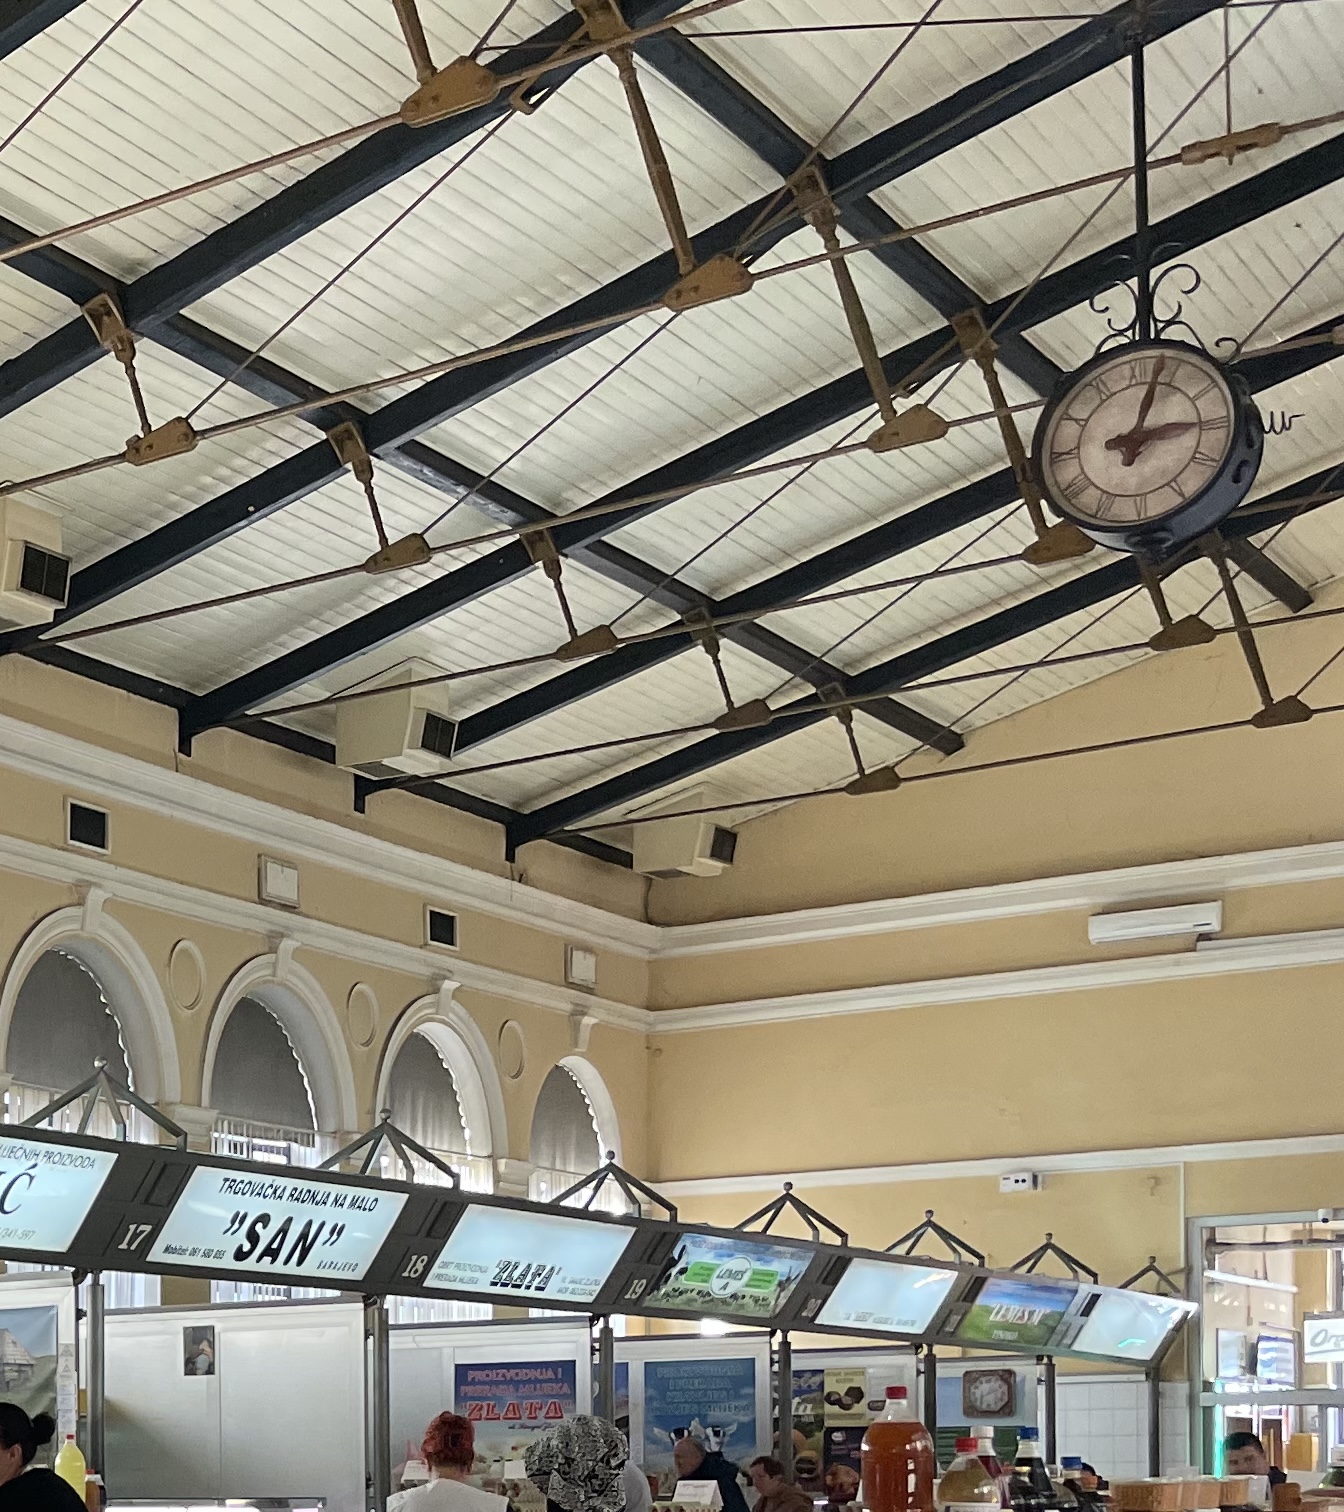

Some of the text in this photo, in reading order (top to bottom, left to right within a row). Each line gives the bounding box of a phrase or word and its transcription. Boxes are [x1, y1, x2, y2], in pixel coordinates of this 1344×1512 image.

[286, 1186, 332, 1207] RADNJA
[329, 1192, 349, 1209] NA
[346, 1194, 379, 1212] MALO
[117, 1223, 153, 1251] 17
[400, 1254, 429, 1279] 18
[624, 1279, 646, 1300] 19
